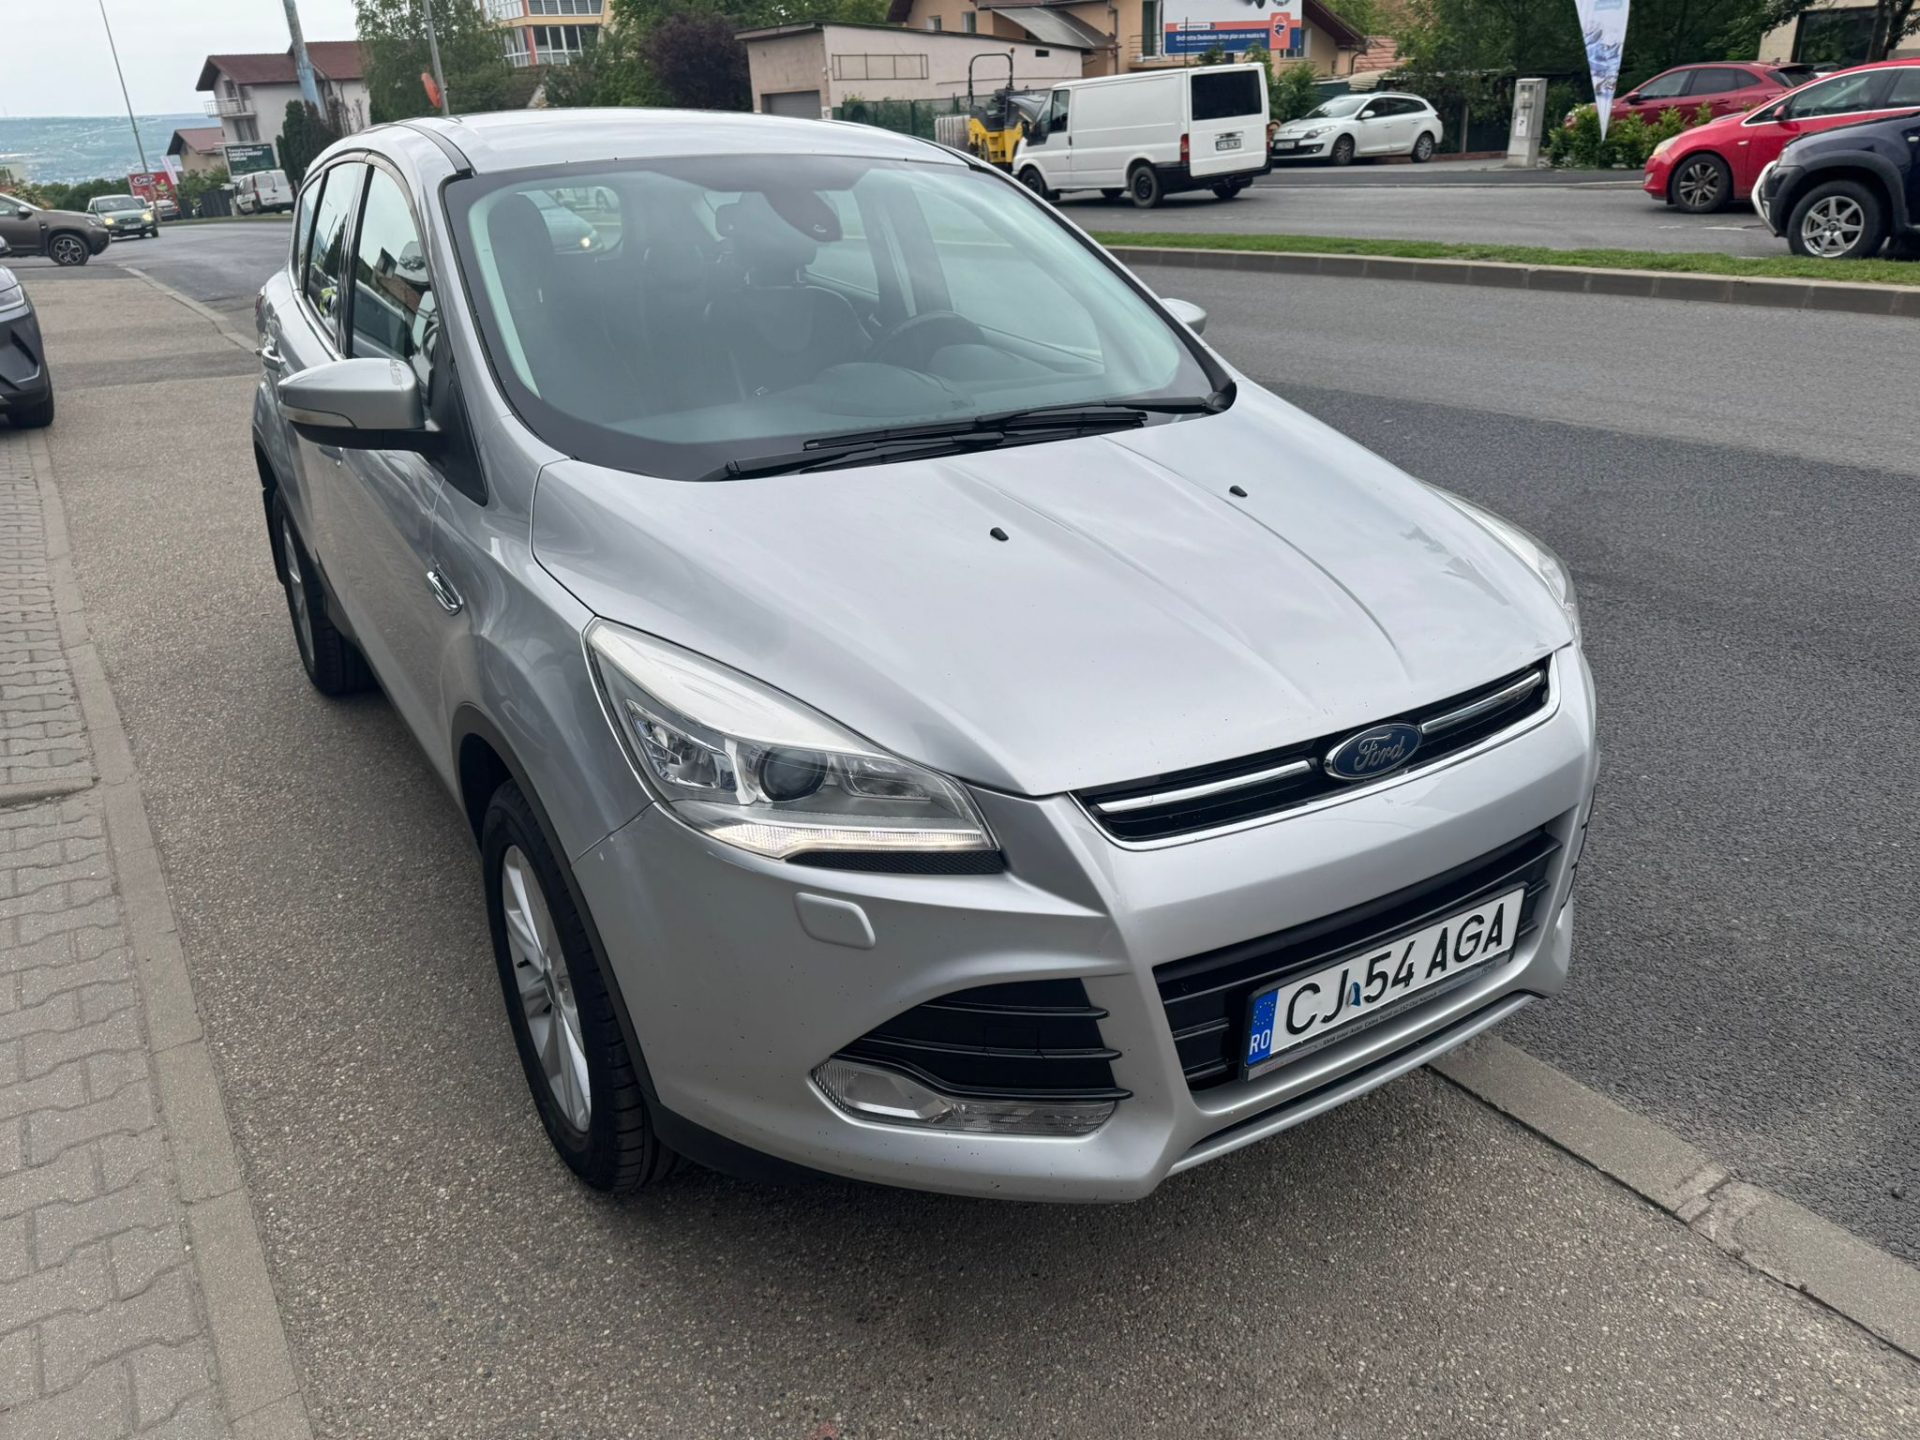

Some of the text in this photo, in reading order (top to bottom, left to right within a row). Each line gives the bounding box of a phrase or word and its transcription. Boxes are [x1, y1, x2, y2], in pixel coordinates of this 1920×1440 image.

[1354, 733, 1405, 771] Ford
[1286, 903, 1504, 1035] CJ 54 AGA
[1250, 1029, 1271, 1056] RO
